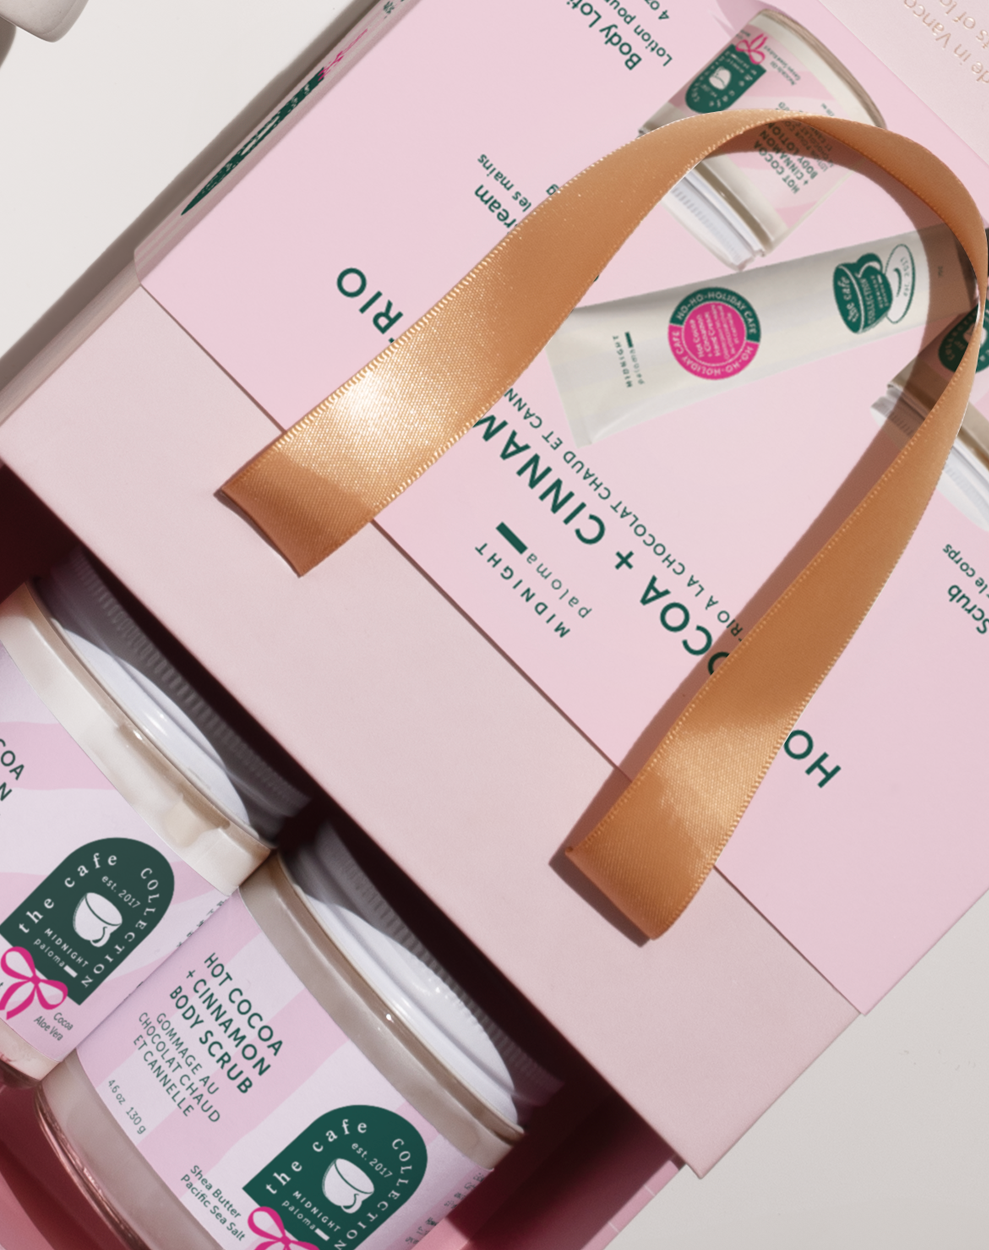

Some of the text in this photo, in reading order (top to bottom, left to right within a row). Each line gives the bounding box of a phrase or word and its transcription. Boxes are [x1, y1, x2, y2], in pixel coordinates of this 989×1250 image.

[658, 10, 670, 20] 4
[952, 11, 976, 30] of
[599, 24, 642, 71] Body
[633, 24, 673, 67] Lotion
[754, 140, 785, 175] COCOA
[759, 130, 804, 181] CINNAMON
[797, 156, 818, 179] BODY
[477, 154, 532, 212] les mains
[782, 175, 800, 194] HOT
[474, 184, 518, 235] ream
[504, 388, 542, 429] CANN
[541, 431, 563, 450] ET
[563, 451, 611, 500] CHAUD
[336, 267, 841, 788] HO COA + CINNAM RIO
[610, 501, 685, 575] CHOCOLAT
[475, 542, 571, 638] MIDNIGHT
[526, 553, 592, 618] paloma
[686, 574, 704, 597] LA
[942, 544, 988, 594] le corps
[717, 610, 743, 642] RIO
[947, 584, 989, 634] Scrub
[64, 852, 118, 888] cafe
[101, 875, 141, 910] est. 2017
[18, 897, 55, 933] the
[81, 867, 160, 987] COLLECTION
[33, 938, 66, 968] paloma
[44, 927, 89, 968] MIDNIGHT
[53, 1012, 73, 1031] Cocoa
[186, 969, 196, 979] +
[193, 978, 271, 1076] CINNAMON
[204, 952, 283, 1057] HOT COCOA
[33, 1015, 64, 1041] Aloe Vera
[169, 985, 204, 1029] BODY
[199, 1029, 253, 1094] SCRUB
[138, 1012, 221, 1122] CHOCOLAT CHAUD
[156, 1013, 219, 1095] GOMMAGE AU
[133, 1034, 194, 1117] ET CANNELLE
[116, 1093, 126, 1105] oz
[126, 1107, 142, 1125] 130
[136, 1125, 146, 1135] g
[312, 1119, 367, 1152] cafe
[264, 1160, 303, 1195] the
[351, 1142, 393, 1179] est. 2017
[180, 1174, 246, 1241] Pacific Sea Salt
[190, 1165, 242, 1219] Shea Butter
[292, 1190, 341, 1232] MIDNIGHT
[334, 1138, 413, 1250] COLLECTION
[281, 1200, 316, 1231] paloma
